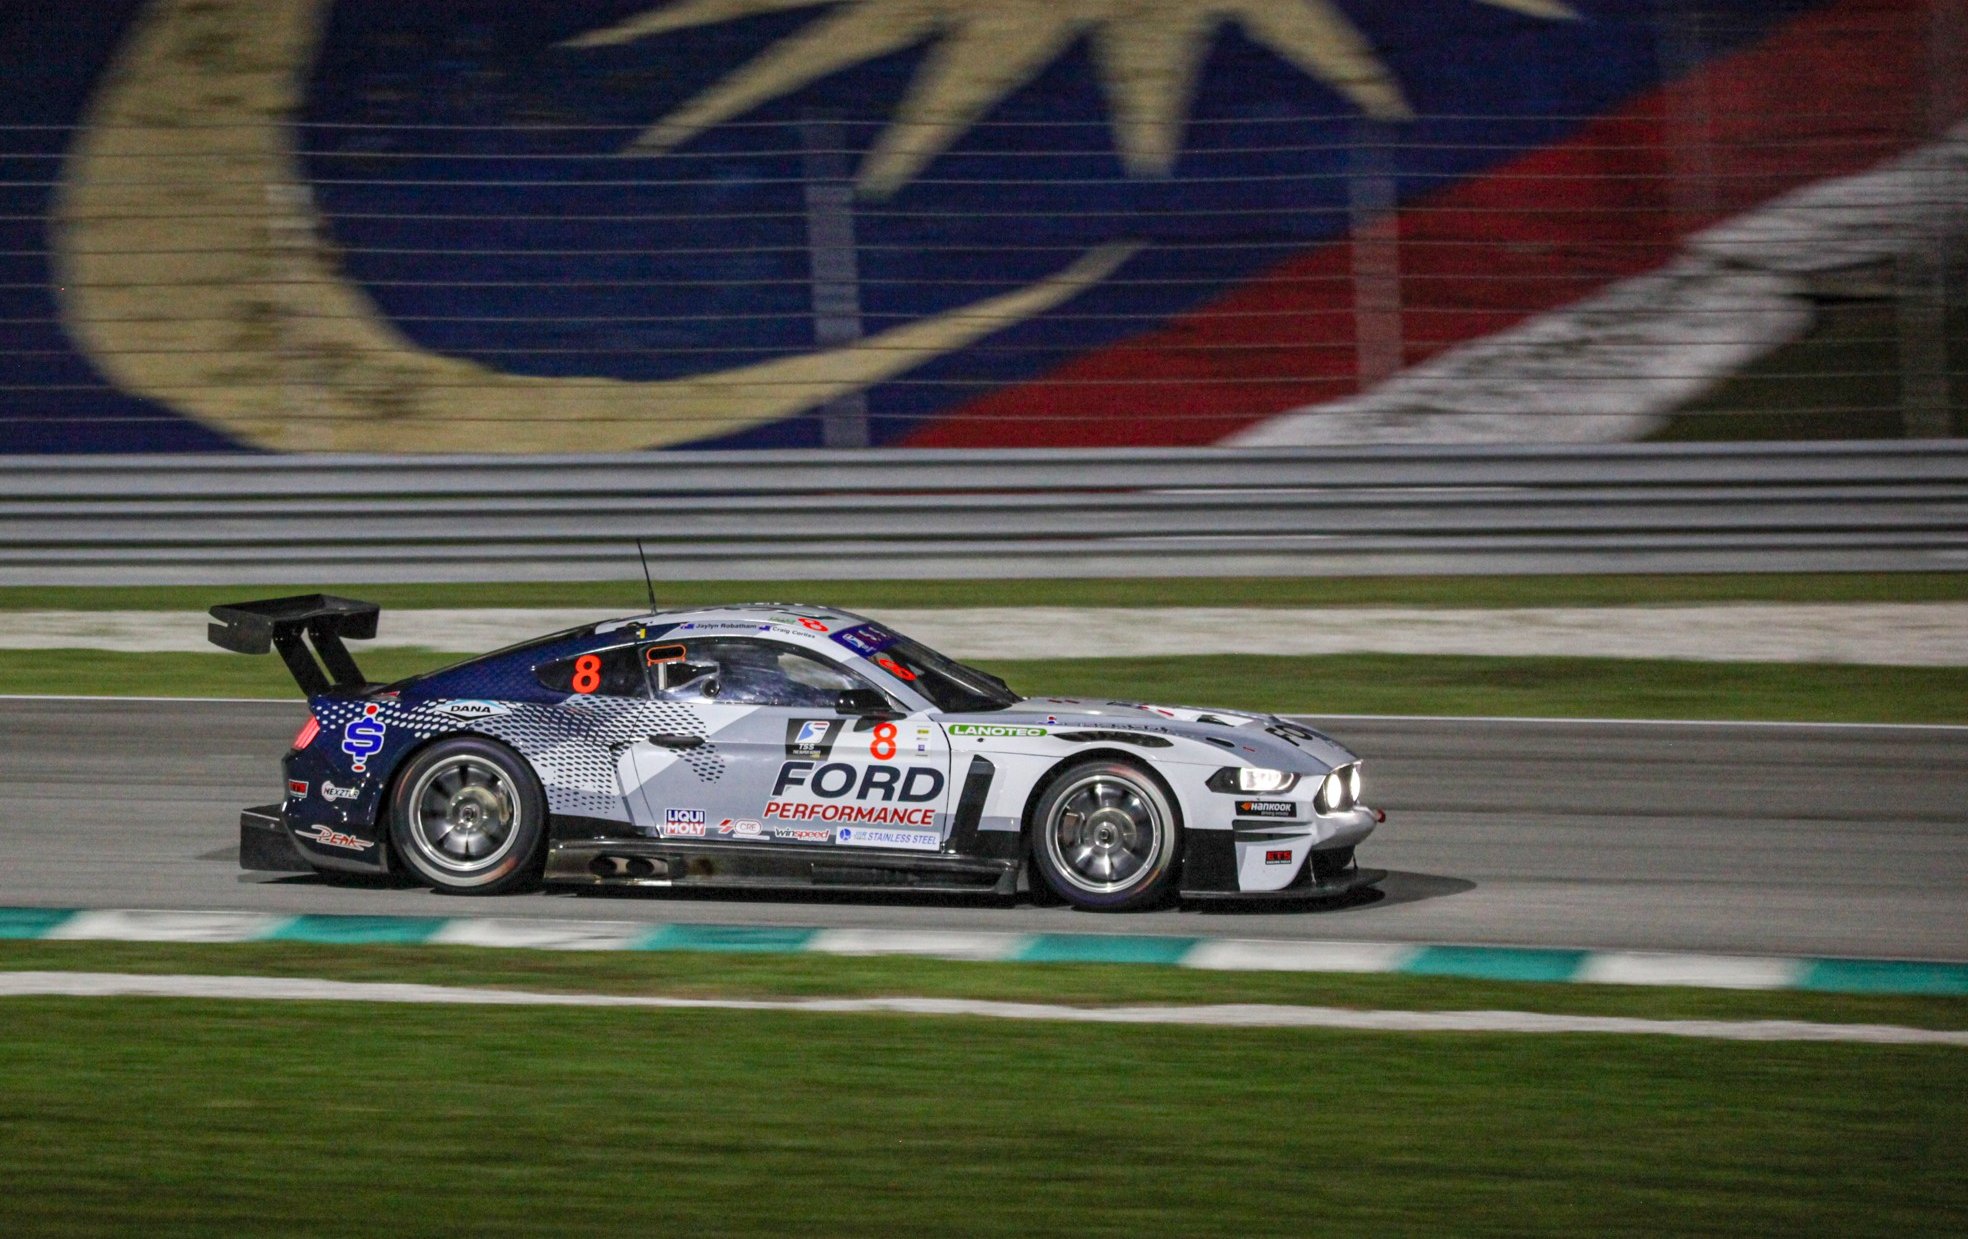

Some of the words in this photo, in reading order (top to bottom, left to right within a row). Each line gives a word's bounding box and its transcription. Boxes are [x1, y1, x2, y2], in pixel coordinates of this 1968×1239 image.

[572, 655, 600, 694] 8
[450, 705, 491, 713] DANA
[954, 725, 1041, 737] LANOTEC
[870, 722, 897, 761] 8
[771, 760, 945, 804] FORD
[667, 810, 704, 822] LIQUI
[763, 802, 936, 826] PERFORMANCE
[667, 822, 704, 835] MOLY
[775, 828, 829, 840] winspeed
[867, 832, 911, 843] STAINLESS
[912, 836, 937, 845] STEEL
